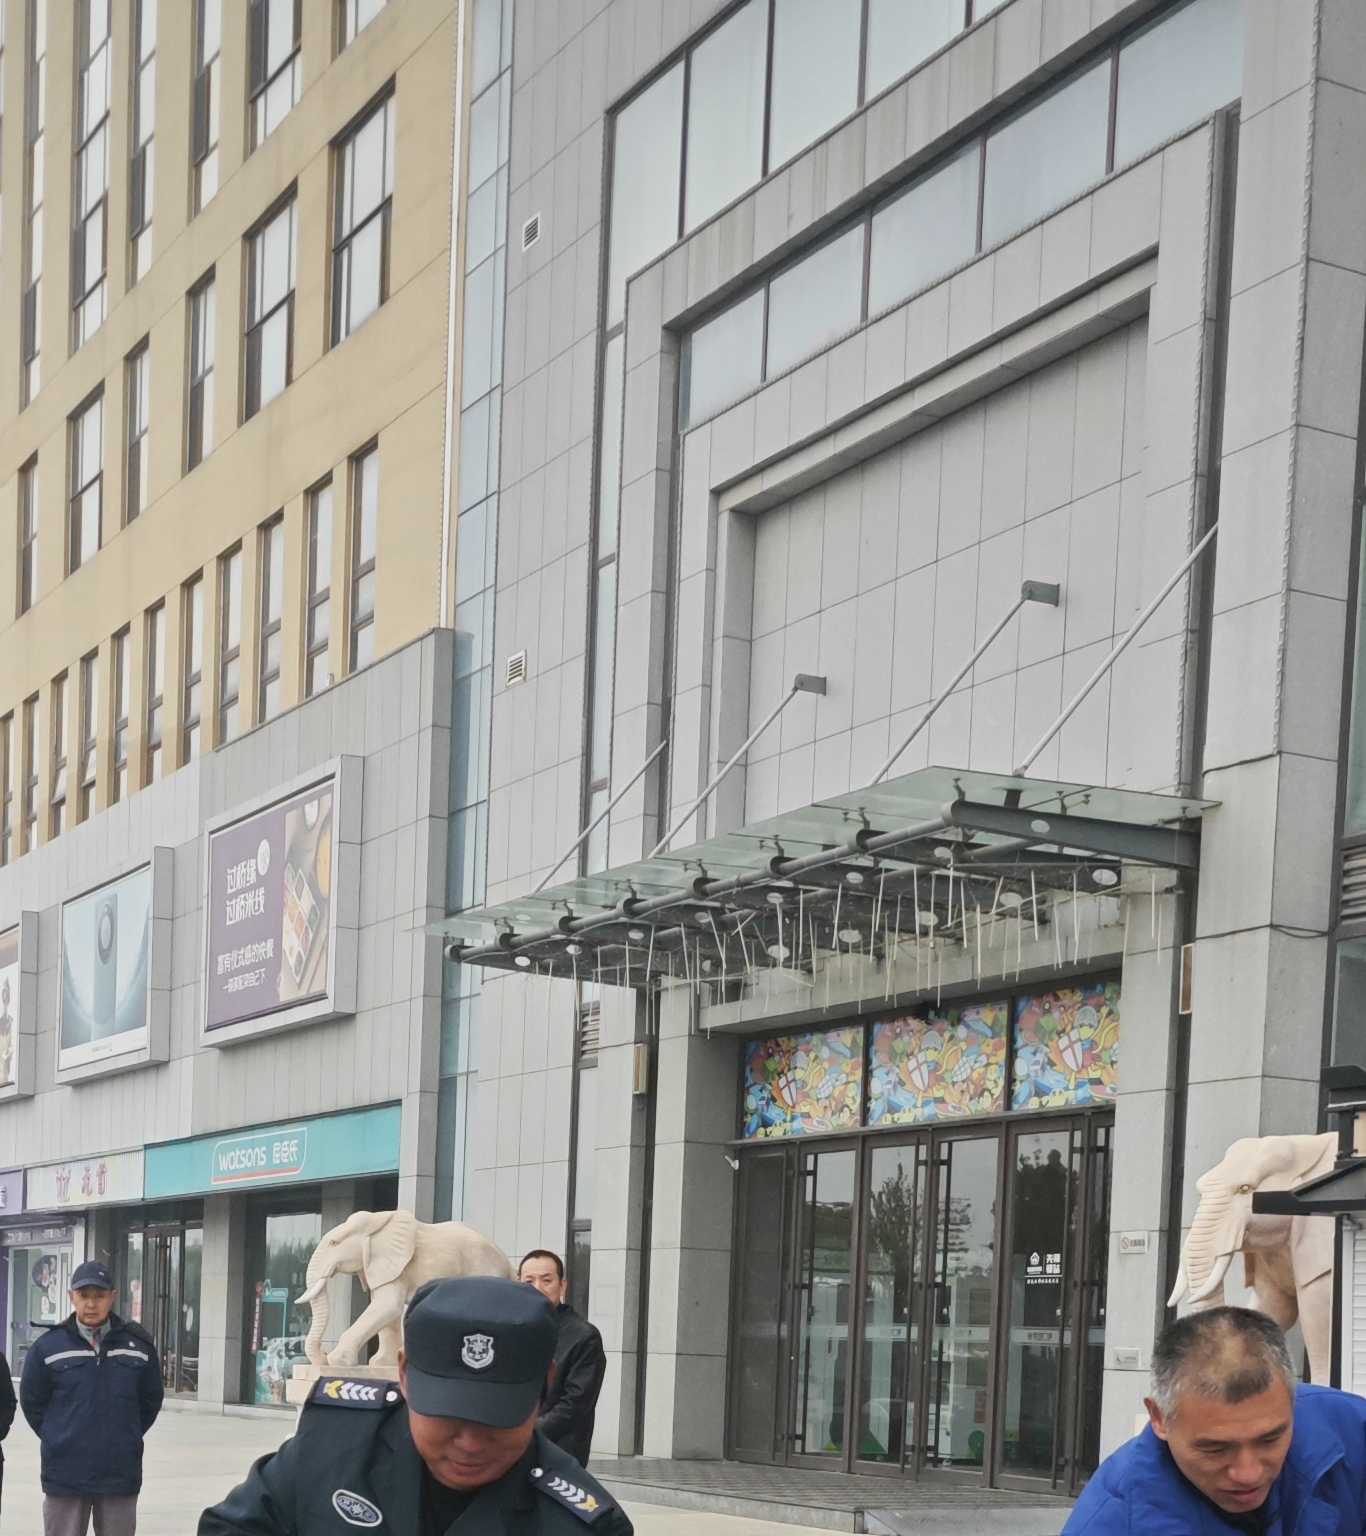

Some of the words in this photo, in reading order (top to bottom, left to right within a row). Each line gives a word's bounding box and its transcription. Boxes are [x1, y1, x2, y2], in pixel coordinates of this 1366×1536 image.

[226, 887, 265, 926] 过桥米线
[219, 1146, 266, 1171] watsons
